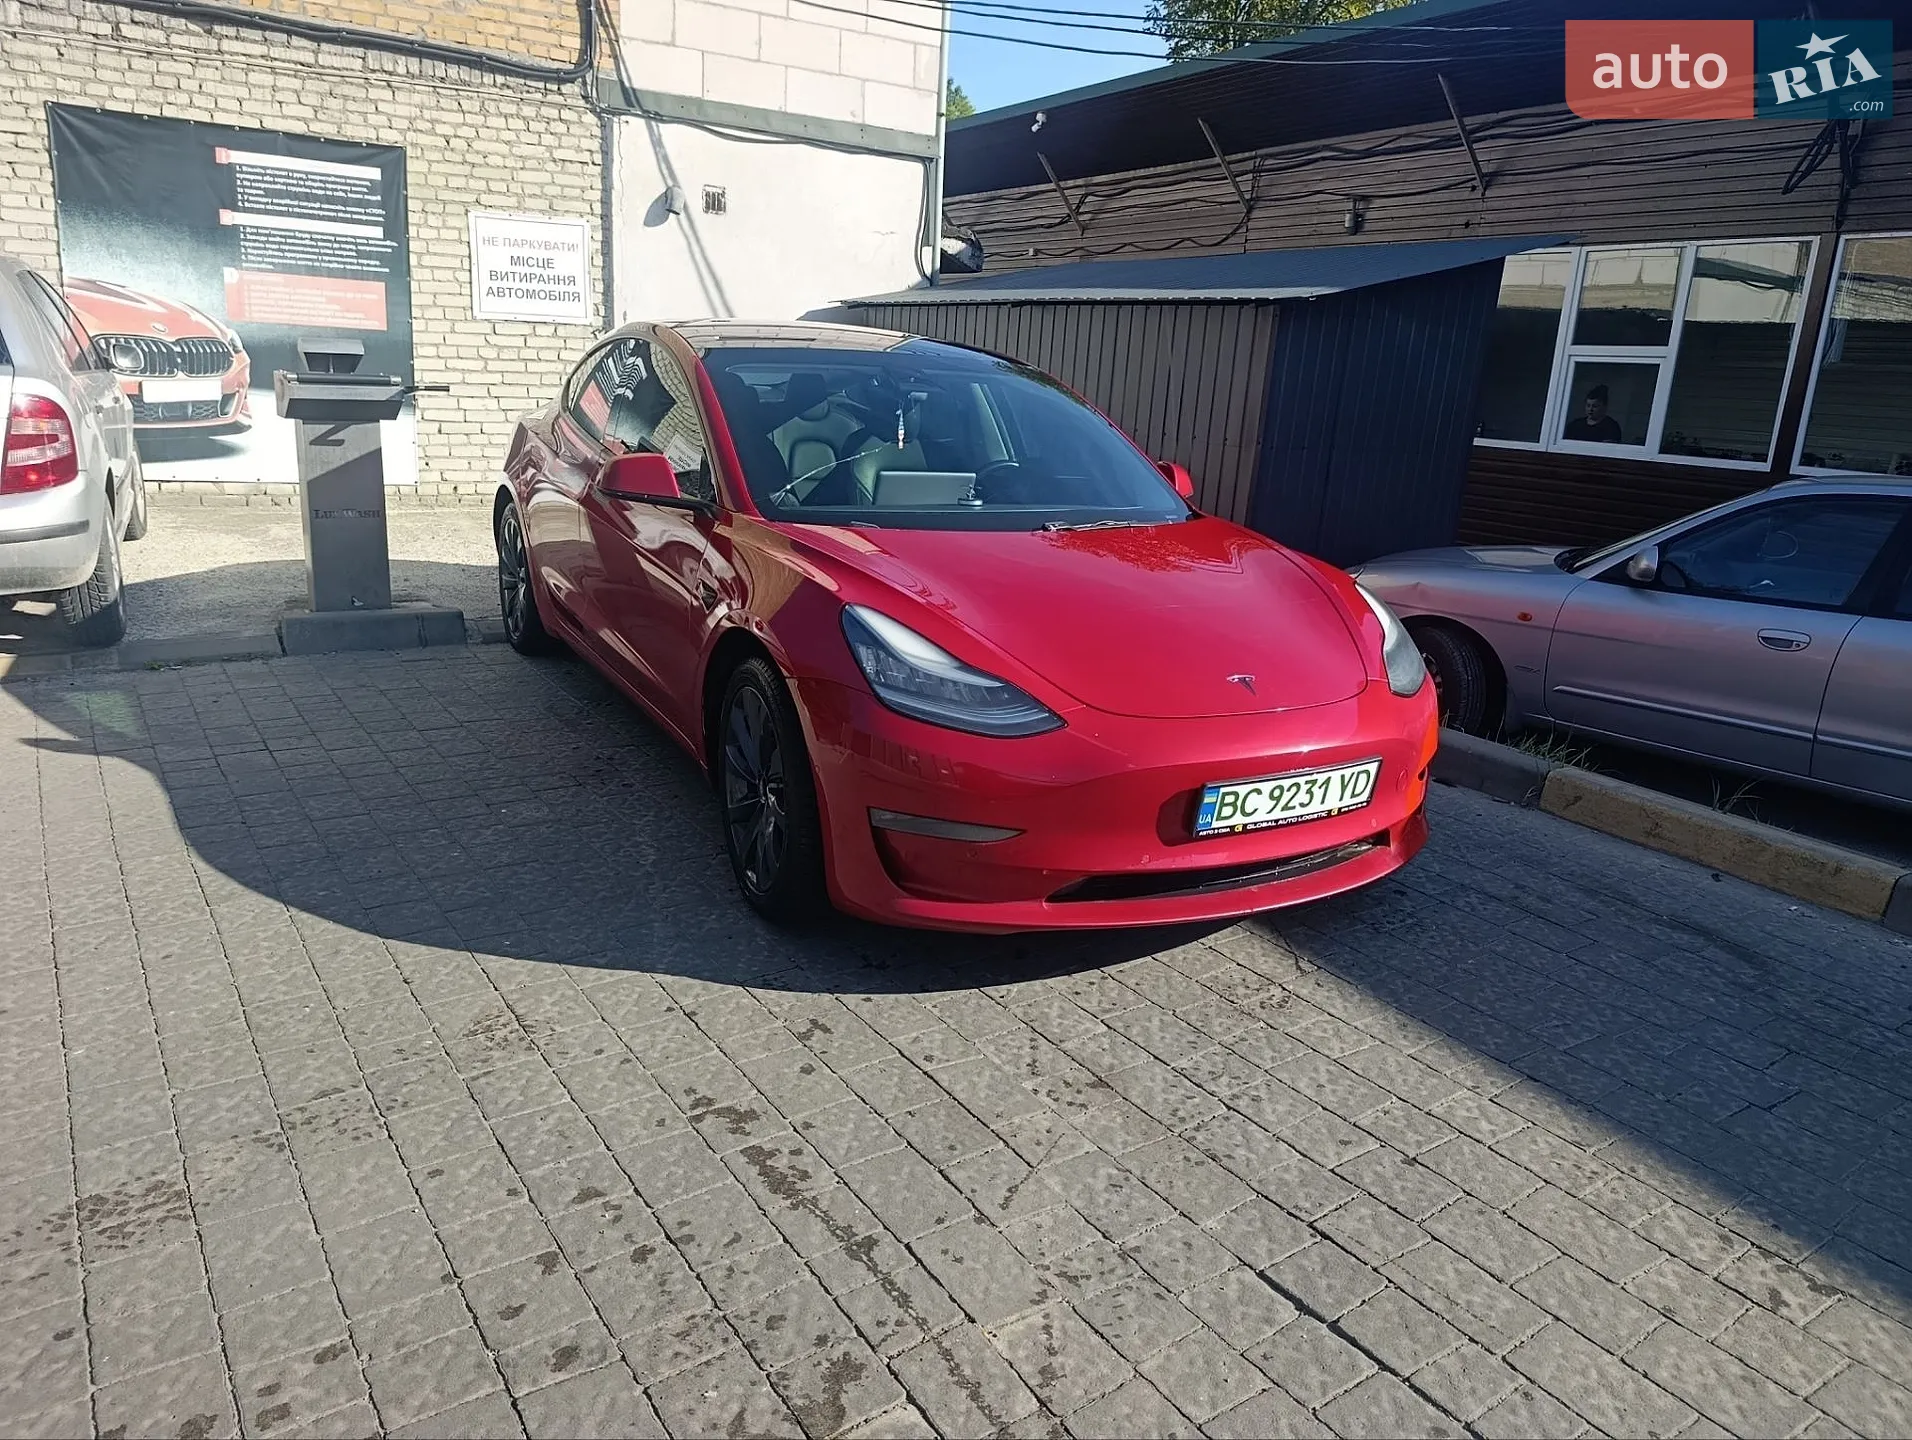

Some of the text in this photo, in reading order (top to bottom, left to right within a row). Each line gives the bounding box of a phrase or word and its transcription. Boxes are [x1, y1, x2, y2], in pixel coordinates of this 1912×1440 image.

[482, 236, 579, 252] НЕ ПАРКУВАТИ!
[510, 255, 555, 270] МІСЦЕ
[489, 270, 576, 287] ВИТИРАННЯ
[486, 286, 581, 303] АВТОМОБІЛЯ
[1215, 769, 1371, 822] BC 9231 YD
[1199, 813, 1212, 824] UA
[1246, 820, 1277, 830] GLOBAL
[1277, 816, 1298, 826] AUTO
